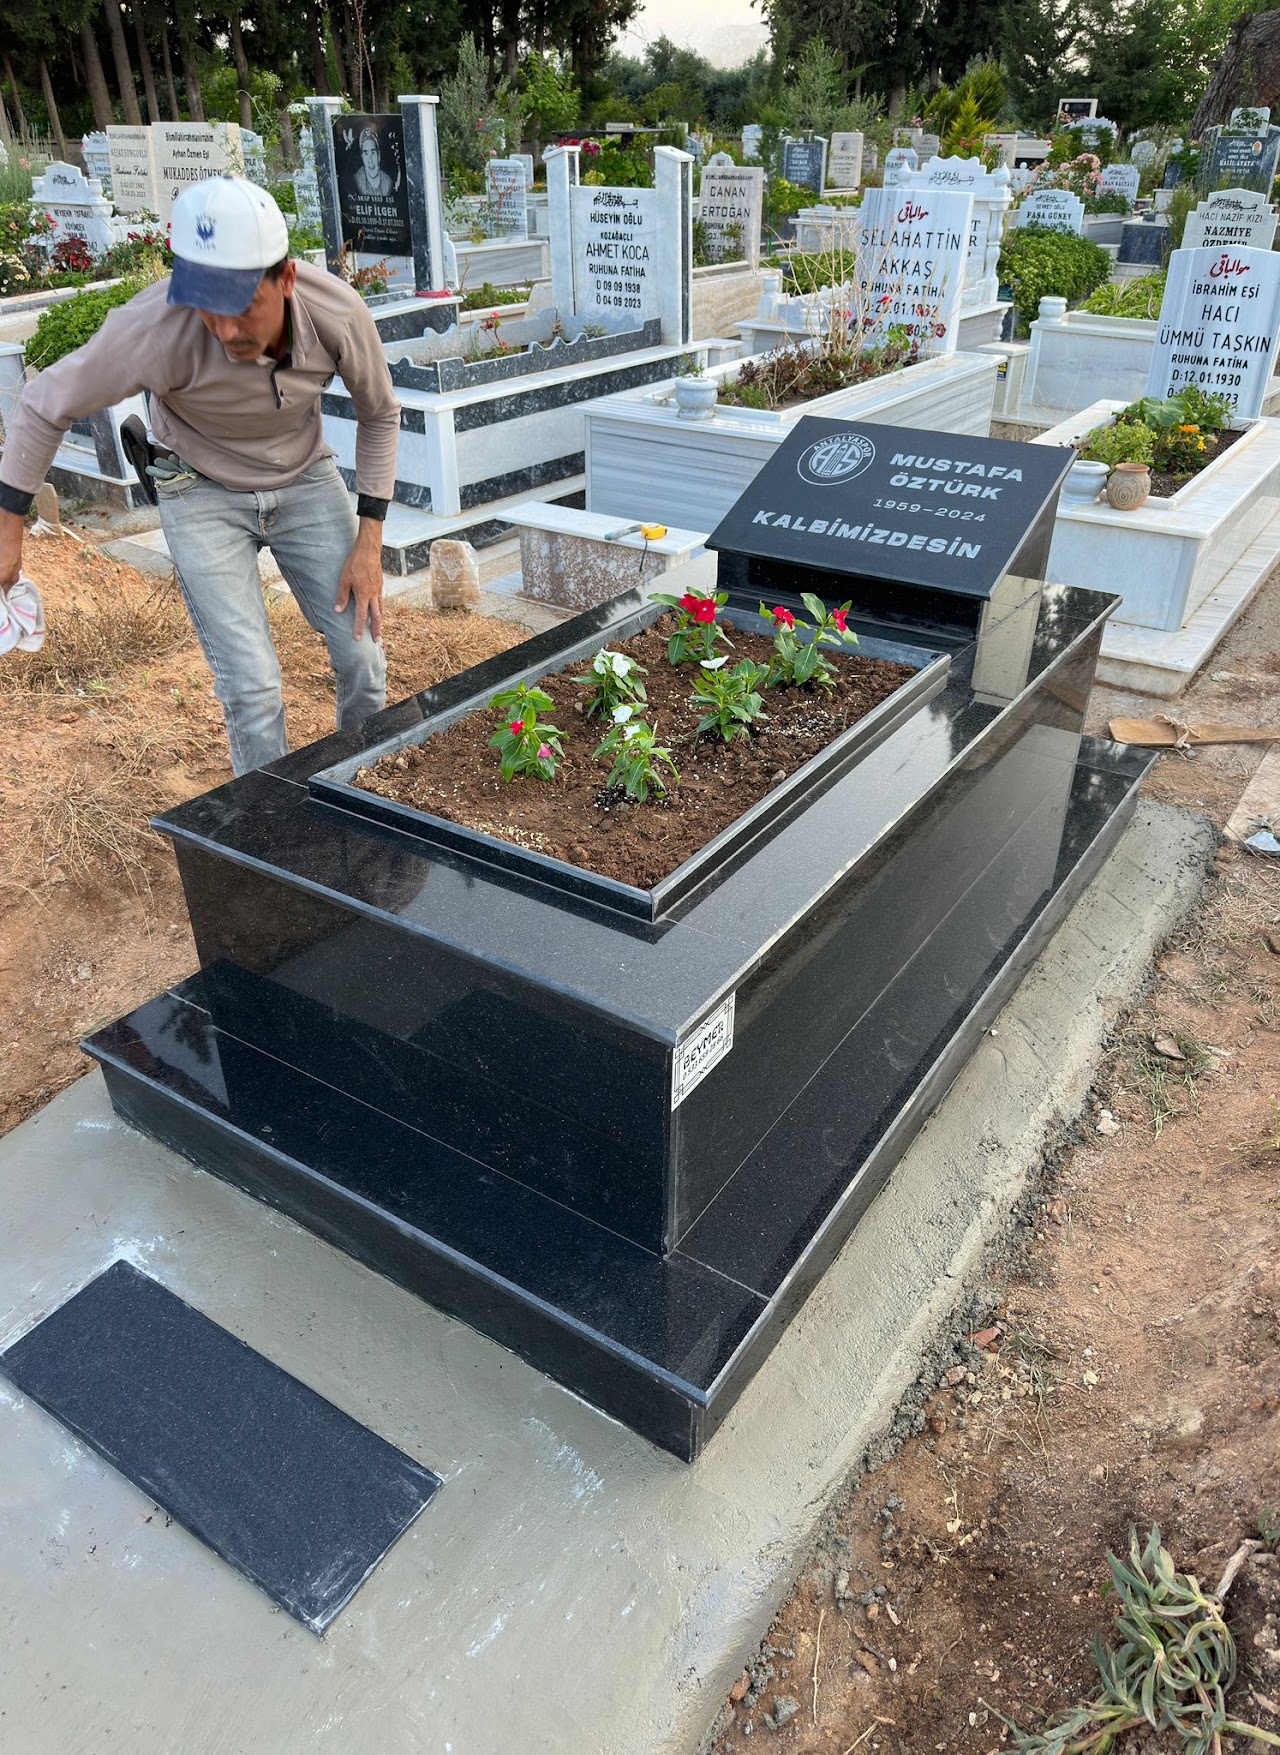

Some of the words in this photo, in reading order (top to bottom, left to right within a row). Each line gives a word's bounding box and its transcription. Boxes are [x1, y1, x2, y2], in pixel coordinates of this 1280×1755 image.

[163, 167, 198, 180] MUKADDES
[710, 186, 746, 198] CANAN
[356, 204, 372, 216] ELİF
[374, 204, 397, 217] İLGEN
[590, 211, 621, 224] HÜSEYİN
[623, 212, 642, 225] OĞLU
[702, 203, 751, 218] ERTOĞAN
[1048, 212, 1072, 220] GÜNEY
[1200, 212, 1218, 220] HACI
[1221, 212, 1244, 222] NAZİF
[1246, 214, 1263, 222] KIZI
[600, 231, 633, 243] KOZAĞAÇLI
[1204, 224, 1252, 237] NAZMİYE
[862, 228, 960, 250] SELAHATTİN
[586, 242, 619, 259] AHMET
[622, 244, 649, 261] KOCA
[589, 263, 618, 275] RUHUNA
[621, 265, 646, 277] FATİHA
[879, 258, 933, 279] AKKAŞ
[603, 280, 612, 290] 09
[614, 282, 622, 292] 09
[625, 282, 640, 294] 1938
[1192, 279, 1238, 297] İBRAHİM
[1241, 284, 1260, 299] EŞİ
[603, 296, 612, 305] 04
[614, 296, 622, 306] 09
[624, 297, 641, 308] 2023
[1202, 304, 1240, 323] HACI
[1160, 324, 1205, 348] ÜMMÜ
[1213, 333, 1271, 353] TAŞKIN
[1171, 354, 1209, 366] RUHUNA
[1213, 356, 1248, 369] FATİHA
[1172, 370, 1241, 386] D:12.01.1930
[813, 436, 871, 458] ANTALYASPOR
[890, 453, 1023, 482] MUSTAFA
[890, 472, 1003, 500] ÖZTÜRK
[752, 510, 982, 559] KALBİMİZDESİN
[683, 1020, 724, 1070] BEYMER
